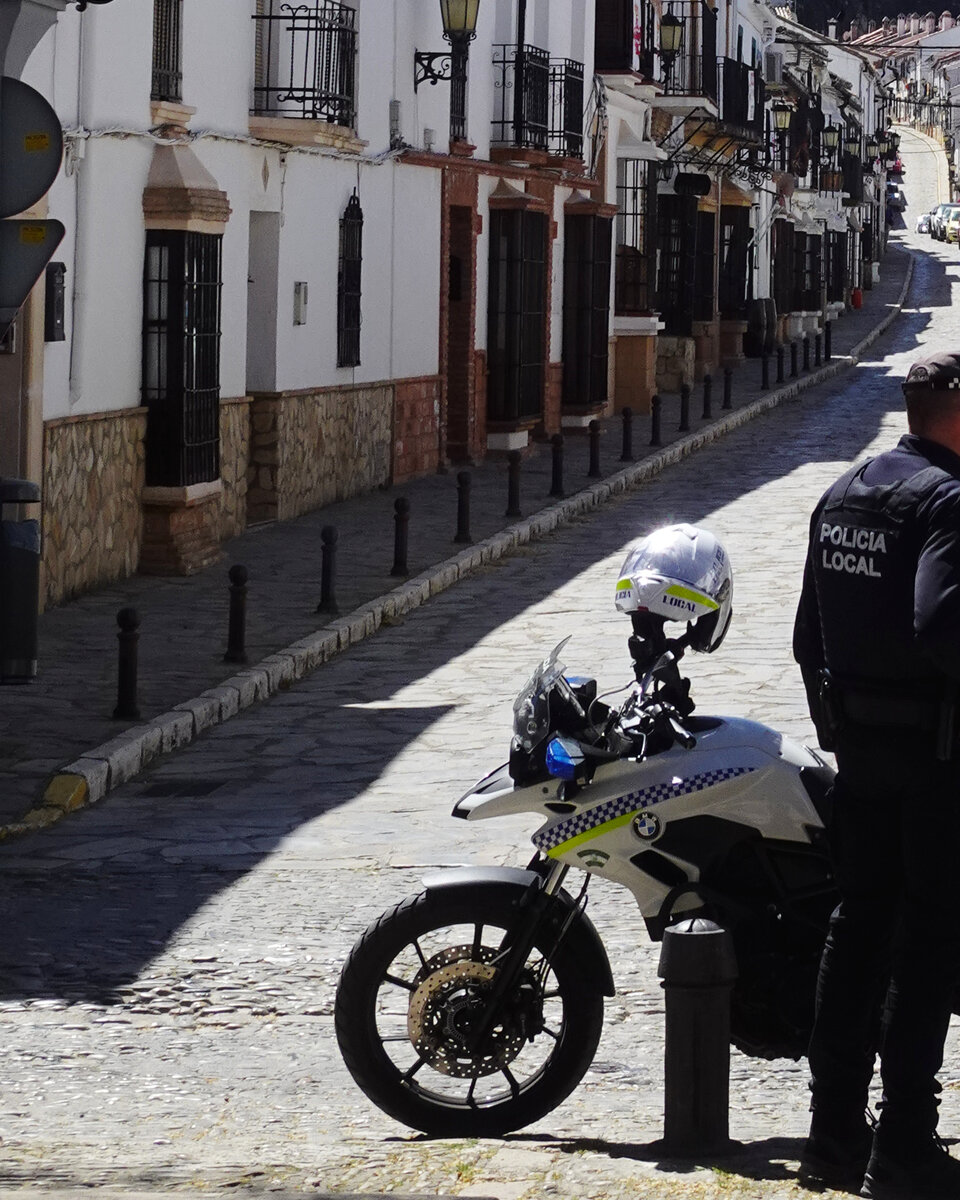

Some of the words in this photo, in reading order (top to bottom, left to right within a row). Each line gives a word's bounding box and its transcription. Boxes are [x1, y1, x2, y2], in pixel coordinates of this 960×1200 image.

[819, 522, 887, 554] POLICIA
[822, 549, 882, 578] LOCAL
[661, 594, 697, 613] LOCAL
